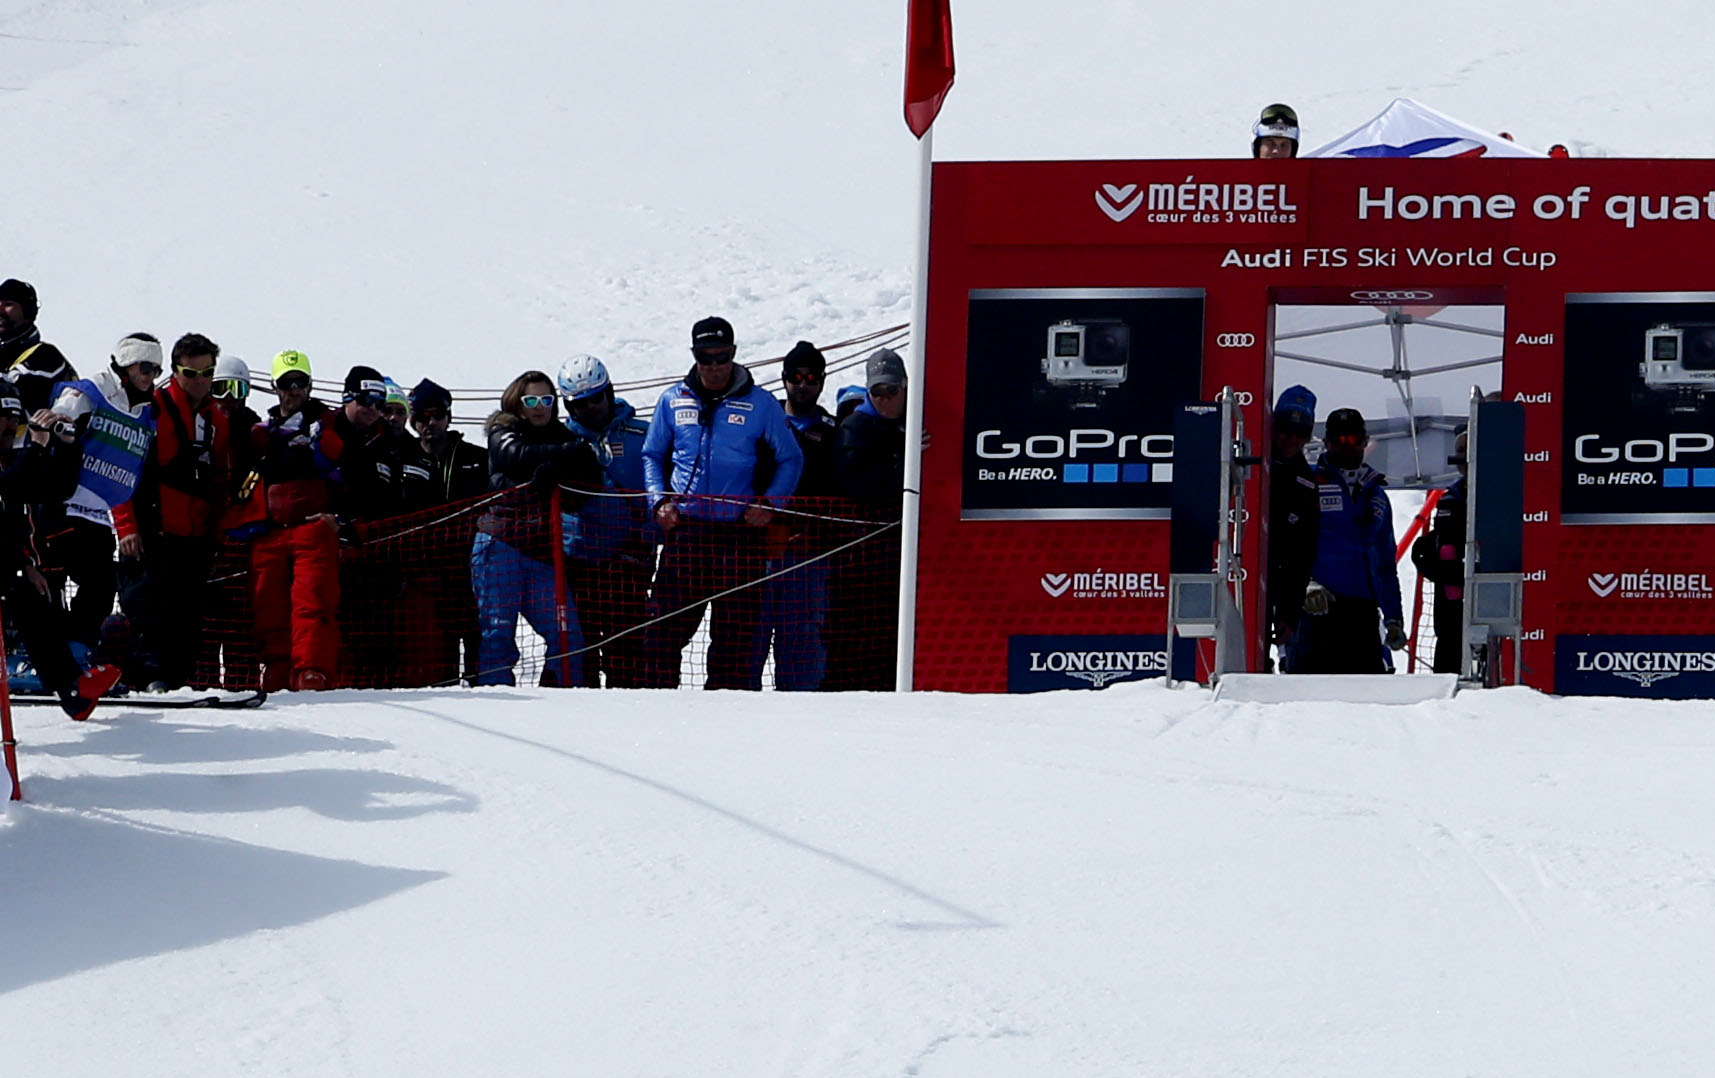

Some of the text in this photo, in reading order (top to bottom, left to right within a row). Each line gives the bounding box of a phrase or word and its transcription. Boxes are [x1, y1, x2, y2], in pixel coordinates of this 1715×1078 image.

[1147, 175, 1297, 211] MÉRIBEL
[1358, 186, 1516, 220] Home
[1532, 186, 1591, 220] of
[1147, 211, 1297, 224] cœur des 3 vallées
[1220, 247, 1557, 271] Audi FIS Ski World Cup
[1515, 333, 1554, 345] Audi
[1513, 391, 1552, 404] Audi
[86, 414, 149, 451] ermophi
[976, 428, 1175, 459] GoPro
[1524, 450, 1549, 462] udi
[978, 467, 1057, 481] Be a HERO.
[1577, 471, 1657, 485] Be a HERO.
[1523, 510, 1548, 522] udi
[1073, 567, 1166, 592] MÉRIBEL
[1523, 569, 1546, 581] udi
[1620, 568, 1713, 593] MÉRIBEL
[1100, 590, 1118, 598] des
[1120, 589, 1127, 598] 3
[1647, 590, 1666, 599] des
[1668, 590, 1675, 599] 3
[1029, 650, 1167, 672] LONGINES
